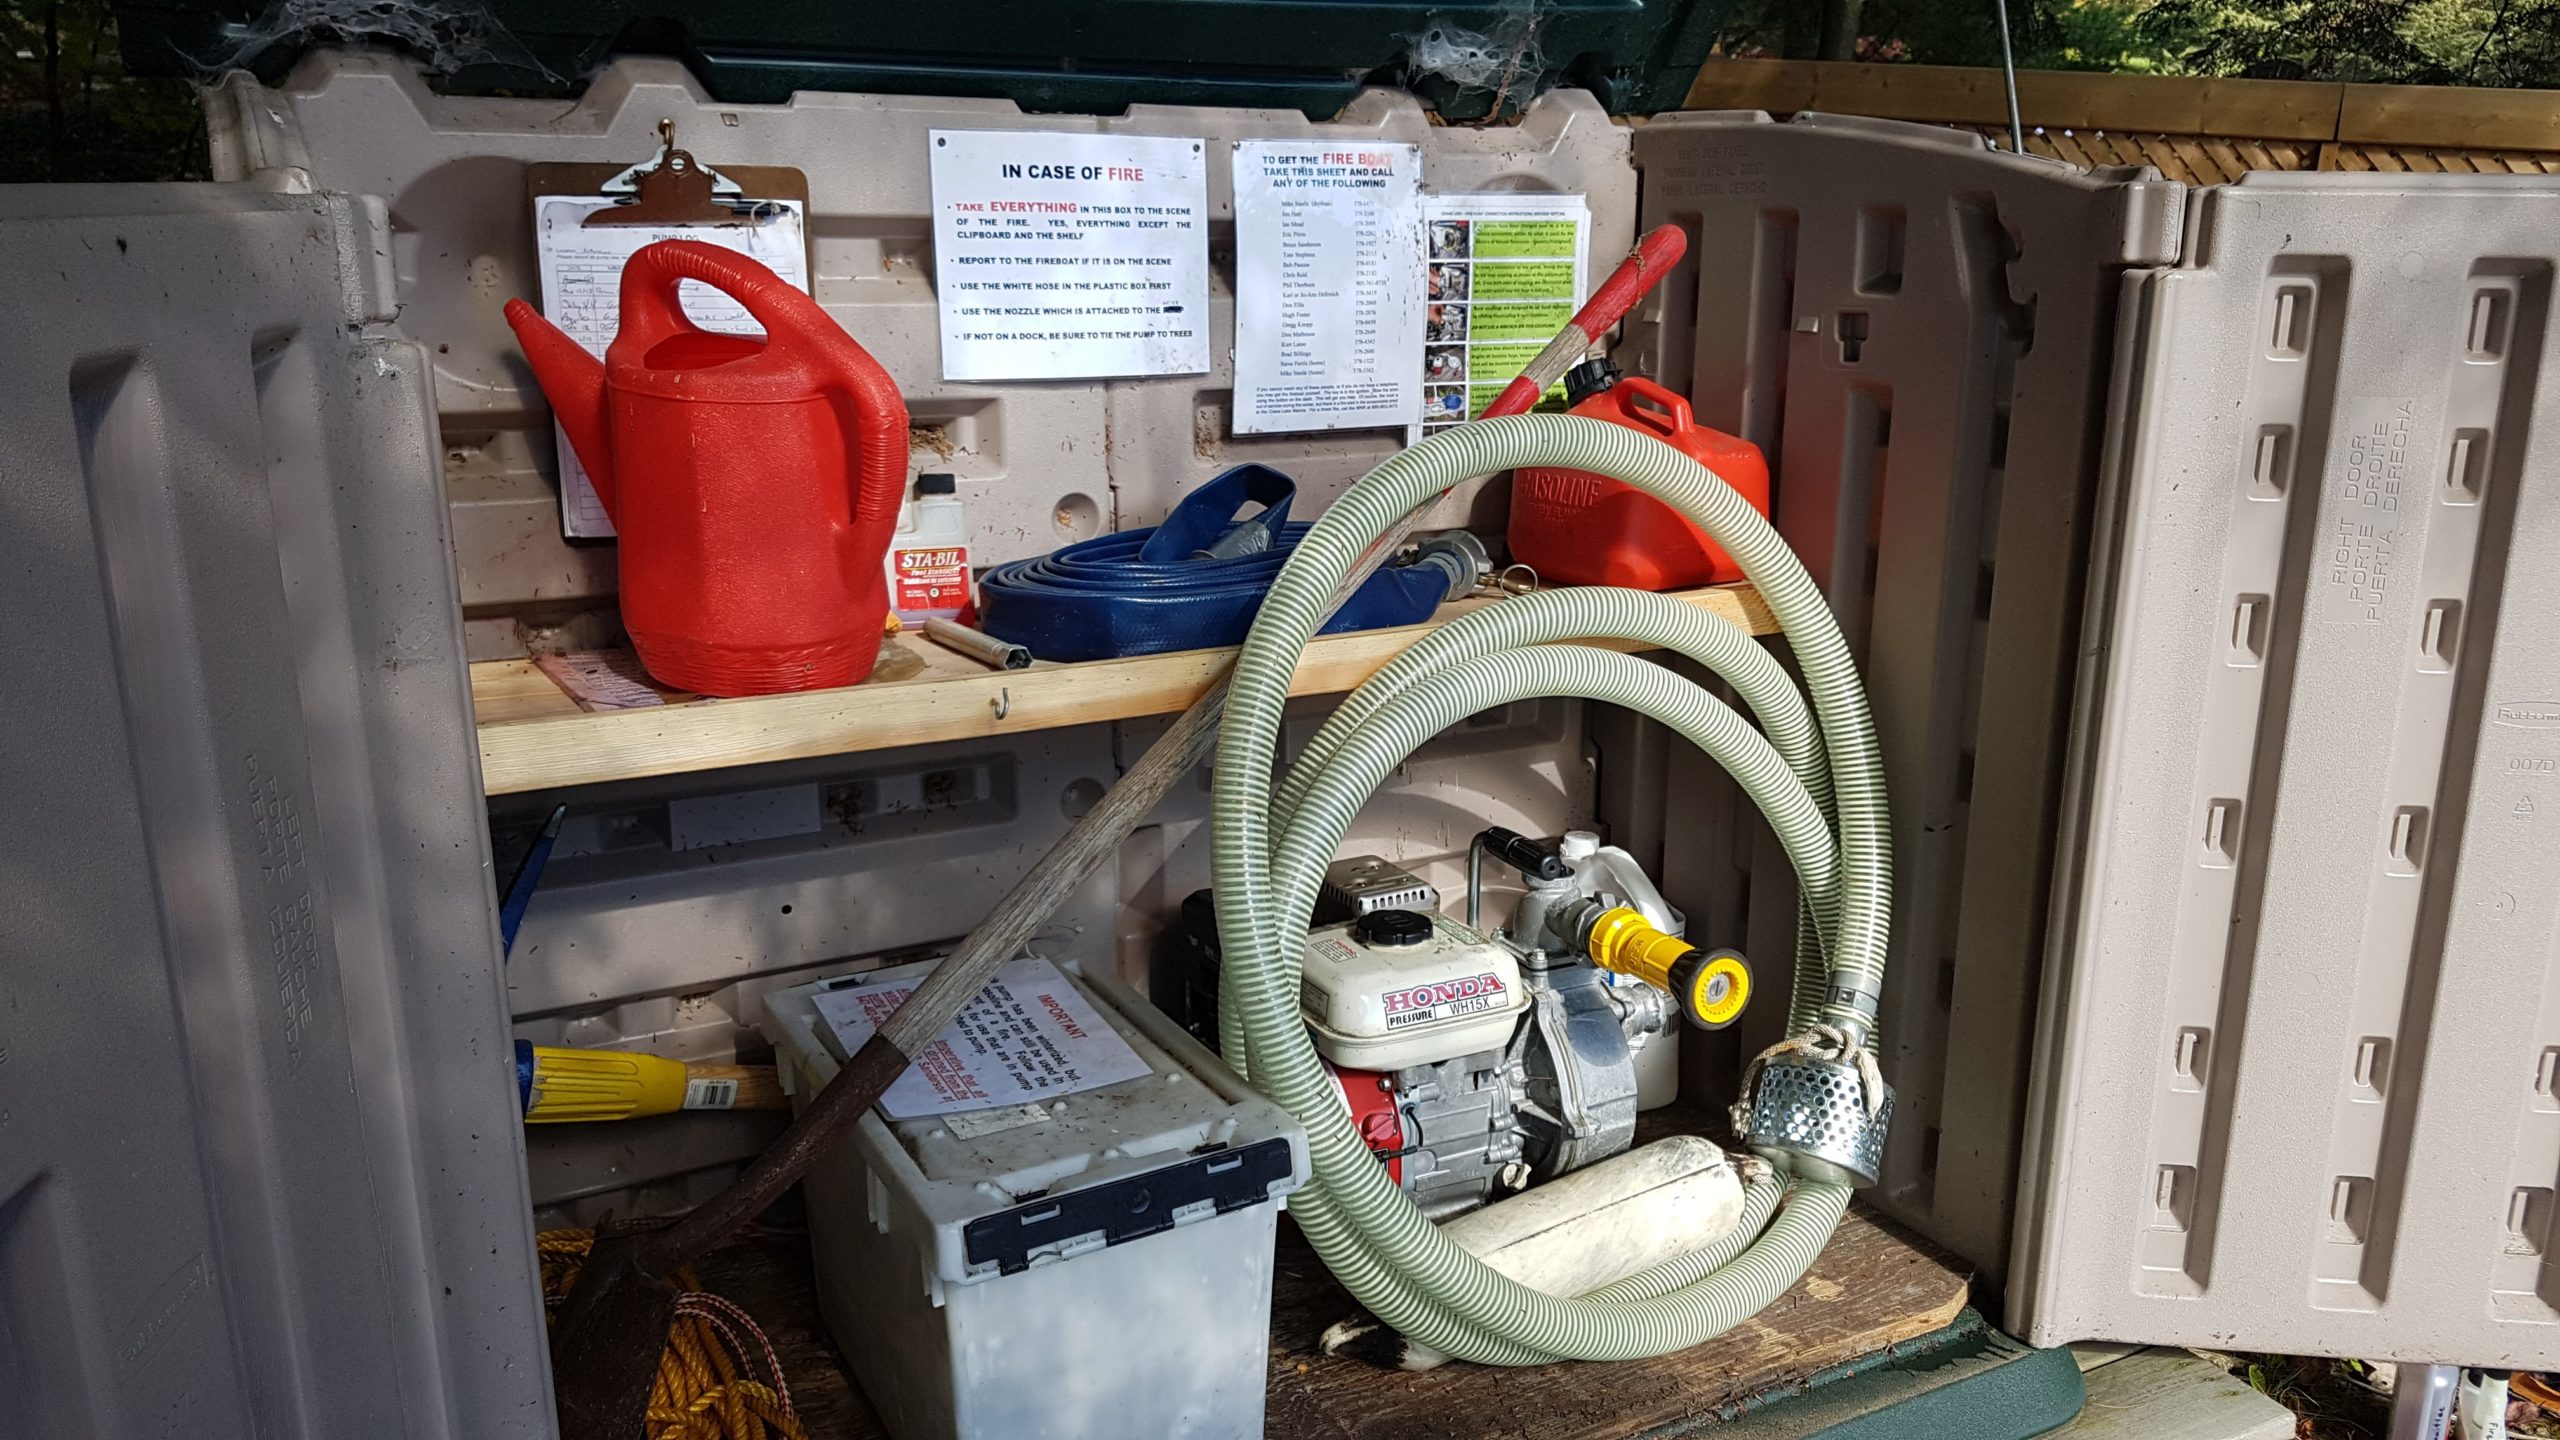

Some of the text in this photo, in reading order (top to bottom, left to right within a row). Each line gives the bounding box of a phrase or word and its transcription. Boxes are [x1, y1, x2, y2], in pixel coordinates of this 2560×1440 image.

[1263, 156, 1275, 164] TO
[1323, 154, 1353, 164] FIRE
[1002, 165, 1144, 181] IN CASE OF FIRE
[1317, 168, 1346, 176] SHEET
[1372, 168, 1394, 176] CALL
[956, 203, 984, 212] TAKE
[991, 202, 1077, 213] EVERYTHING
[1093, 206, 1112, 214] THIS
[1048, 220, 1068, 228] YES,
[1036, 232, 1054, 240] THE
[1057, 232, 1084, 240] SHELF
[1149, 282, 1171, 290] FIRST
[1020, 333, 1047, 341] DOCK,
[1520, 470, 1602, 509] GASOLINE
[2332, 435, 2367, 585] RIGHT DOOR
[2350, 422, 2389, 601] PORTE DROITE
[2366, 400, 2412, 621] PUERTA DERECHA
[2498, 707, 2560, 721] Rubberm
[285, 793, 319, 975] LEFT DOOR
[266, 776, 313, 1029] PORTE GAUCHE
[1385, 975, 1504, 1012] HONDA
[968, 1012, 981, 1021] for
[1036, 994, 1088, 1039] IMPORTANT
[1389, 997, 1490, 1026] PRESSURE WH15X
[976, 1024, 990, 1035] use
[982, 986, 1064, 1084] asoline and can still be used in
[993, 985, 1014, 1001] pump
[1011, 1004, 1025, 1015] has
[1021, 1017, 1039, 1032] been
[1065, 1069, 1081, 1081] but
[986, 1037, 1003, 1050] that
[996, 1028, 1011, 1041] fire.
[1014, 1050, 1037, 1072] Follow
[1035, 1076, 1048, 1087] the
[997, 1051, 1010, 1062] are
[1006, 1062, 1018, 1071] in
[1010, 1072, 1033, 1091] pump
